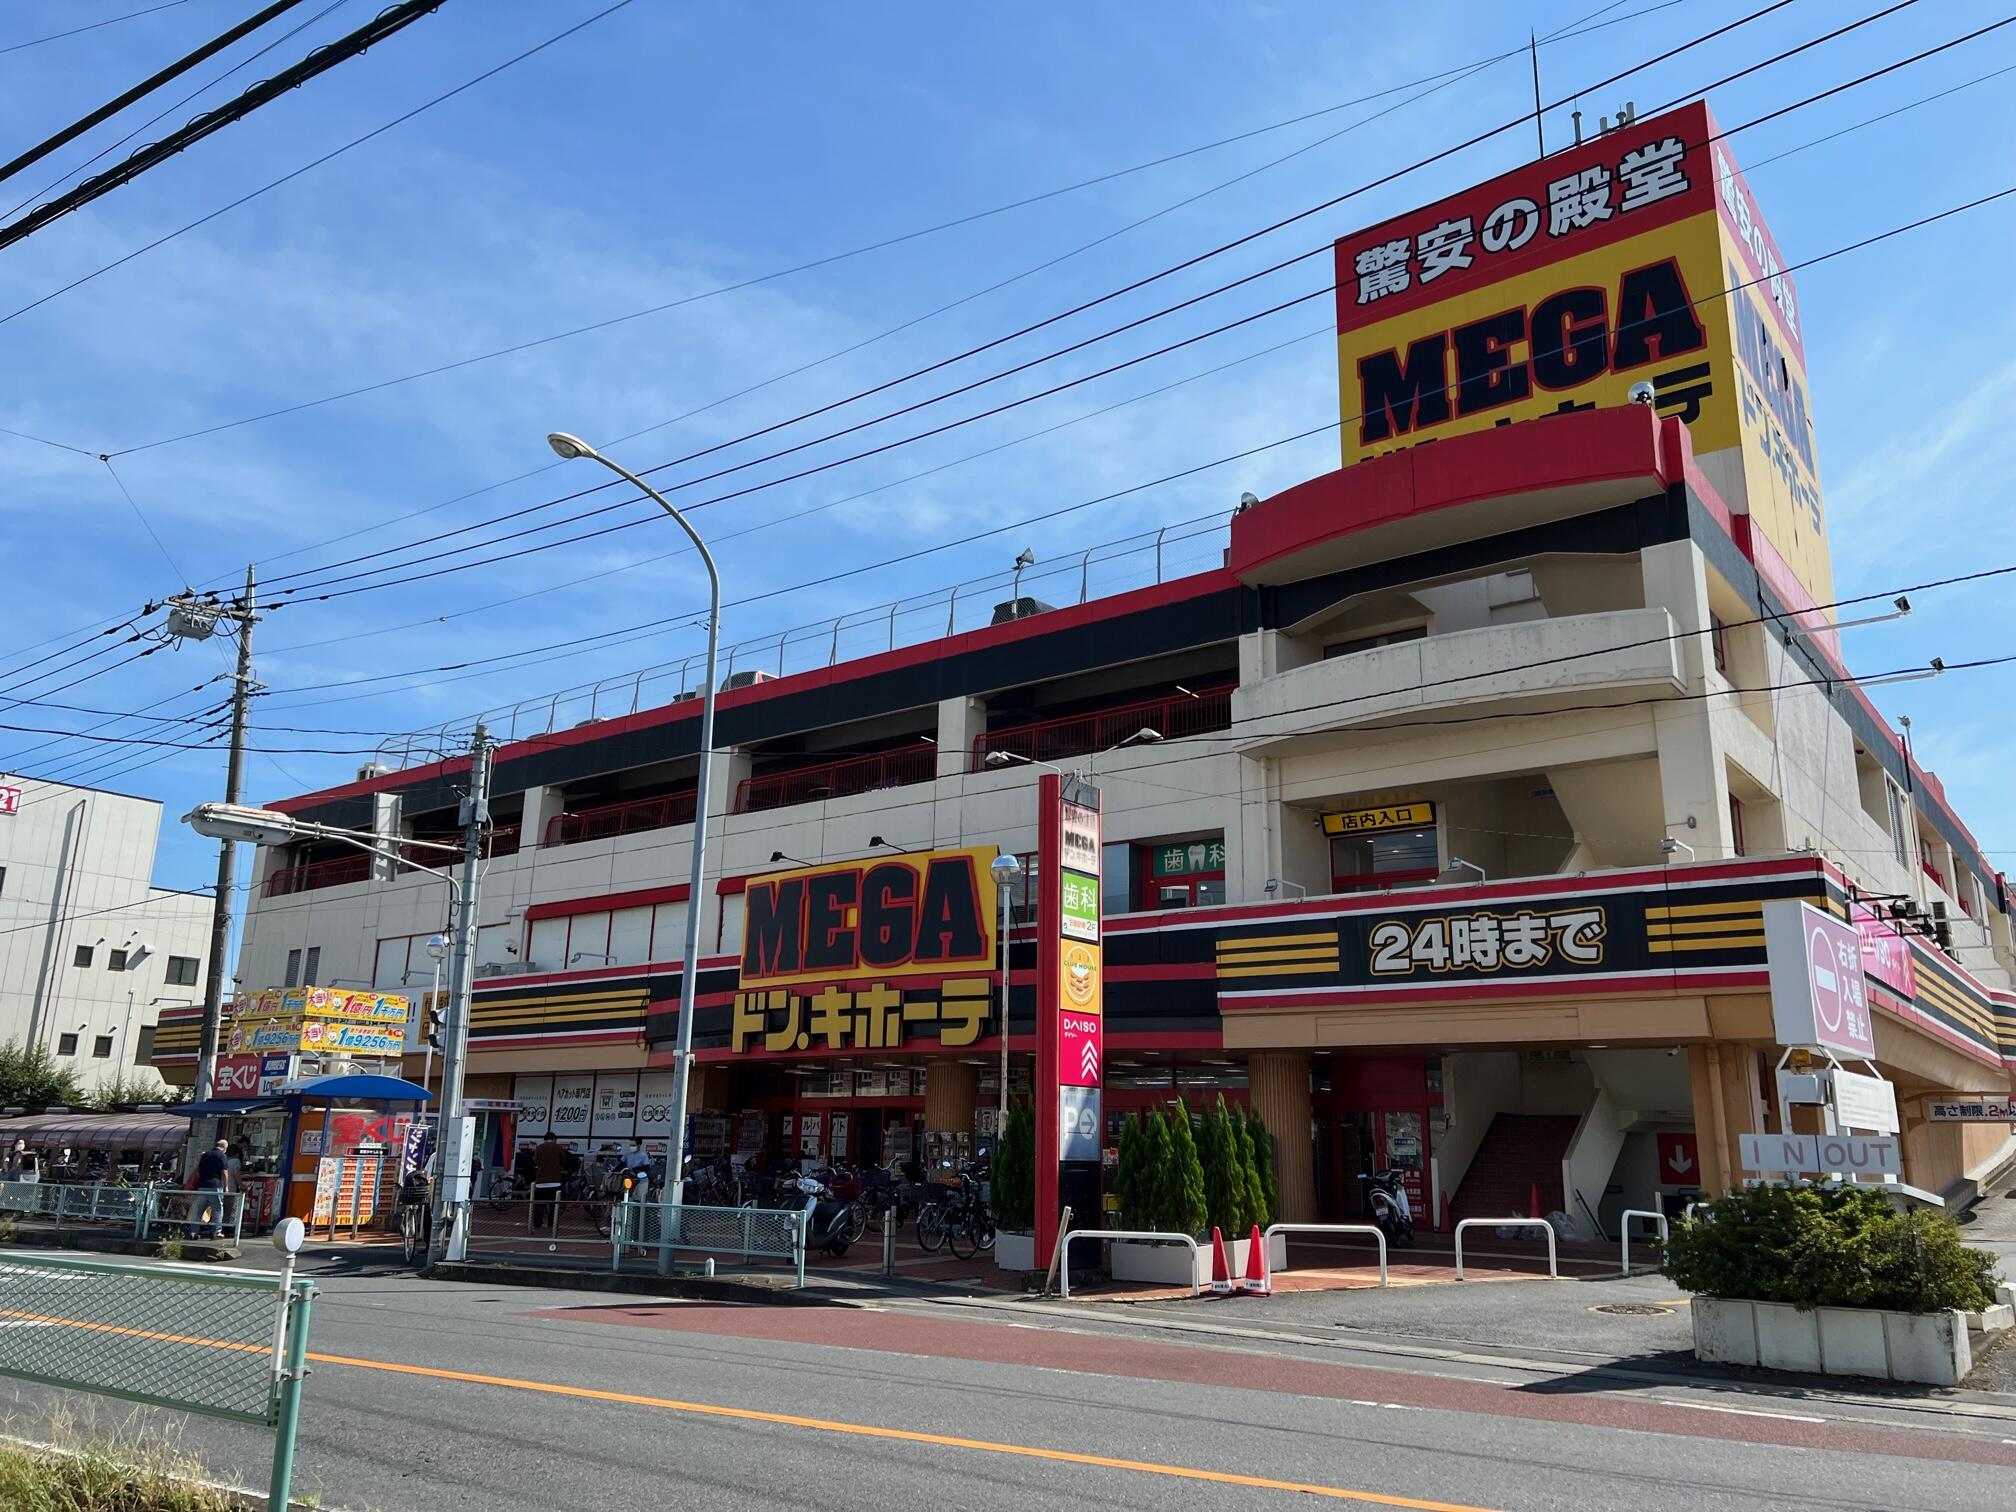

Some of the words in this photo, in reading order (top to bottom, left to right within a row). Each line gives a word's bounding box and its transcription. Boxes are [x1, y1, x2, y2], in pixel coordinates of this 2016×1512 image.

[1355, 138, 1688, 305] 驚安の殿堂
[1358, 257, 1706, 446] MEGA
[1341, 809, 1412, 829] 店内入口
[1065, 831, 1096, 854] MEGA
[1164, 843, 1225, 872] 歯科
[1064, 882, 1097, 915] 歯科
[743, 855, 988, 980] MEGA
[1371, 907, 1605, 973] 24時まで
[1837, 939, 1858, 972] 右折
[342, 994, 372, 1015] 1億円
[372, 998, 405, 1018] 1千万円
[1843, 975, 1863, 1008] 入場
[338, 1027, 401, 1050] 1億9256万円
[1064, 1019, 1096, 1033] DAISO
[1846, 1009, 1868, 1042] 禁止
[217, 1066, 257, 1091] 宝くじ
[1064, 1107, 1078, 1139] P
[1824, 1142, 1892, 1167] OUT
